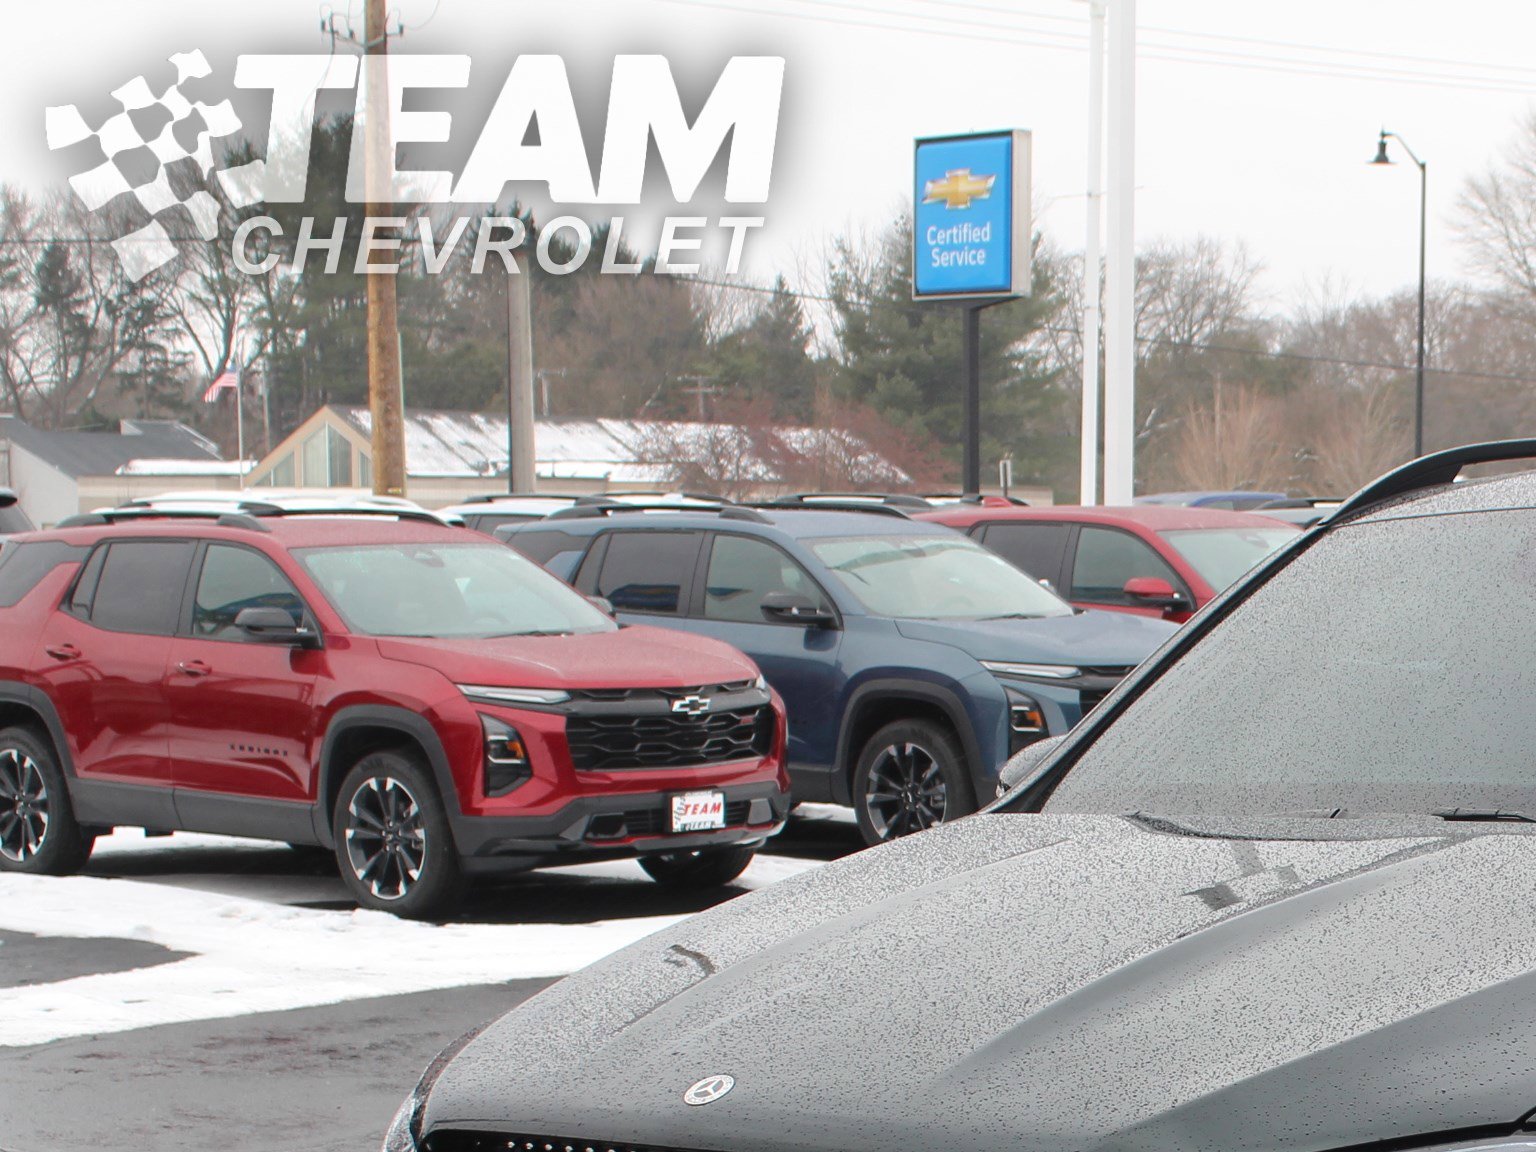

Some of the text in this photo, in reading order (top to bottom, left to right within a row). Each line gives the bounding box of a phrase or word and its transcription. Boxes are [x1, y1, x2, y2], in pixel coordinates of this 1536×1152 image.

[927, 221, 991, 245] Certified
[931, 246, 985, 268] Service
[684, 802, 721, 816] TEAM
